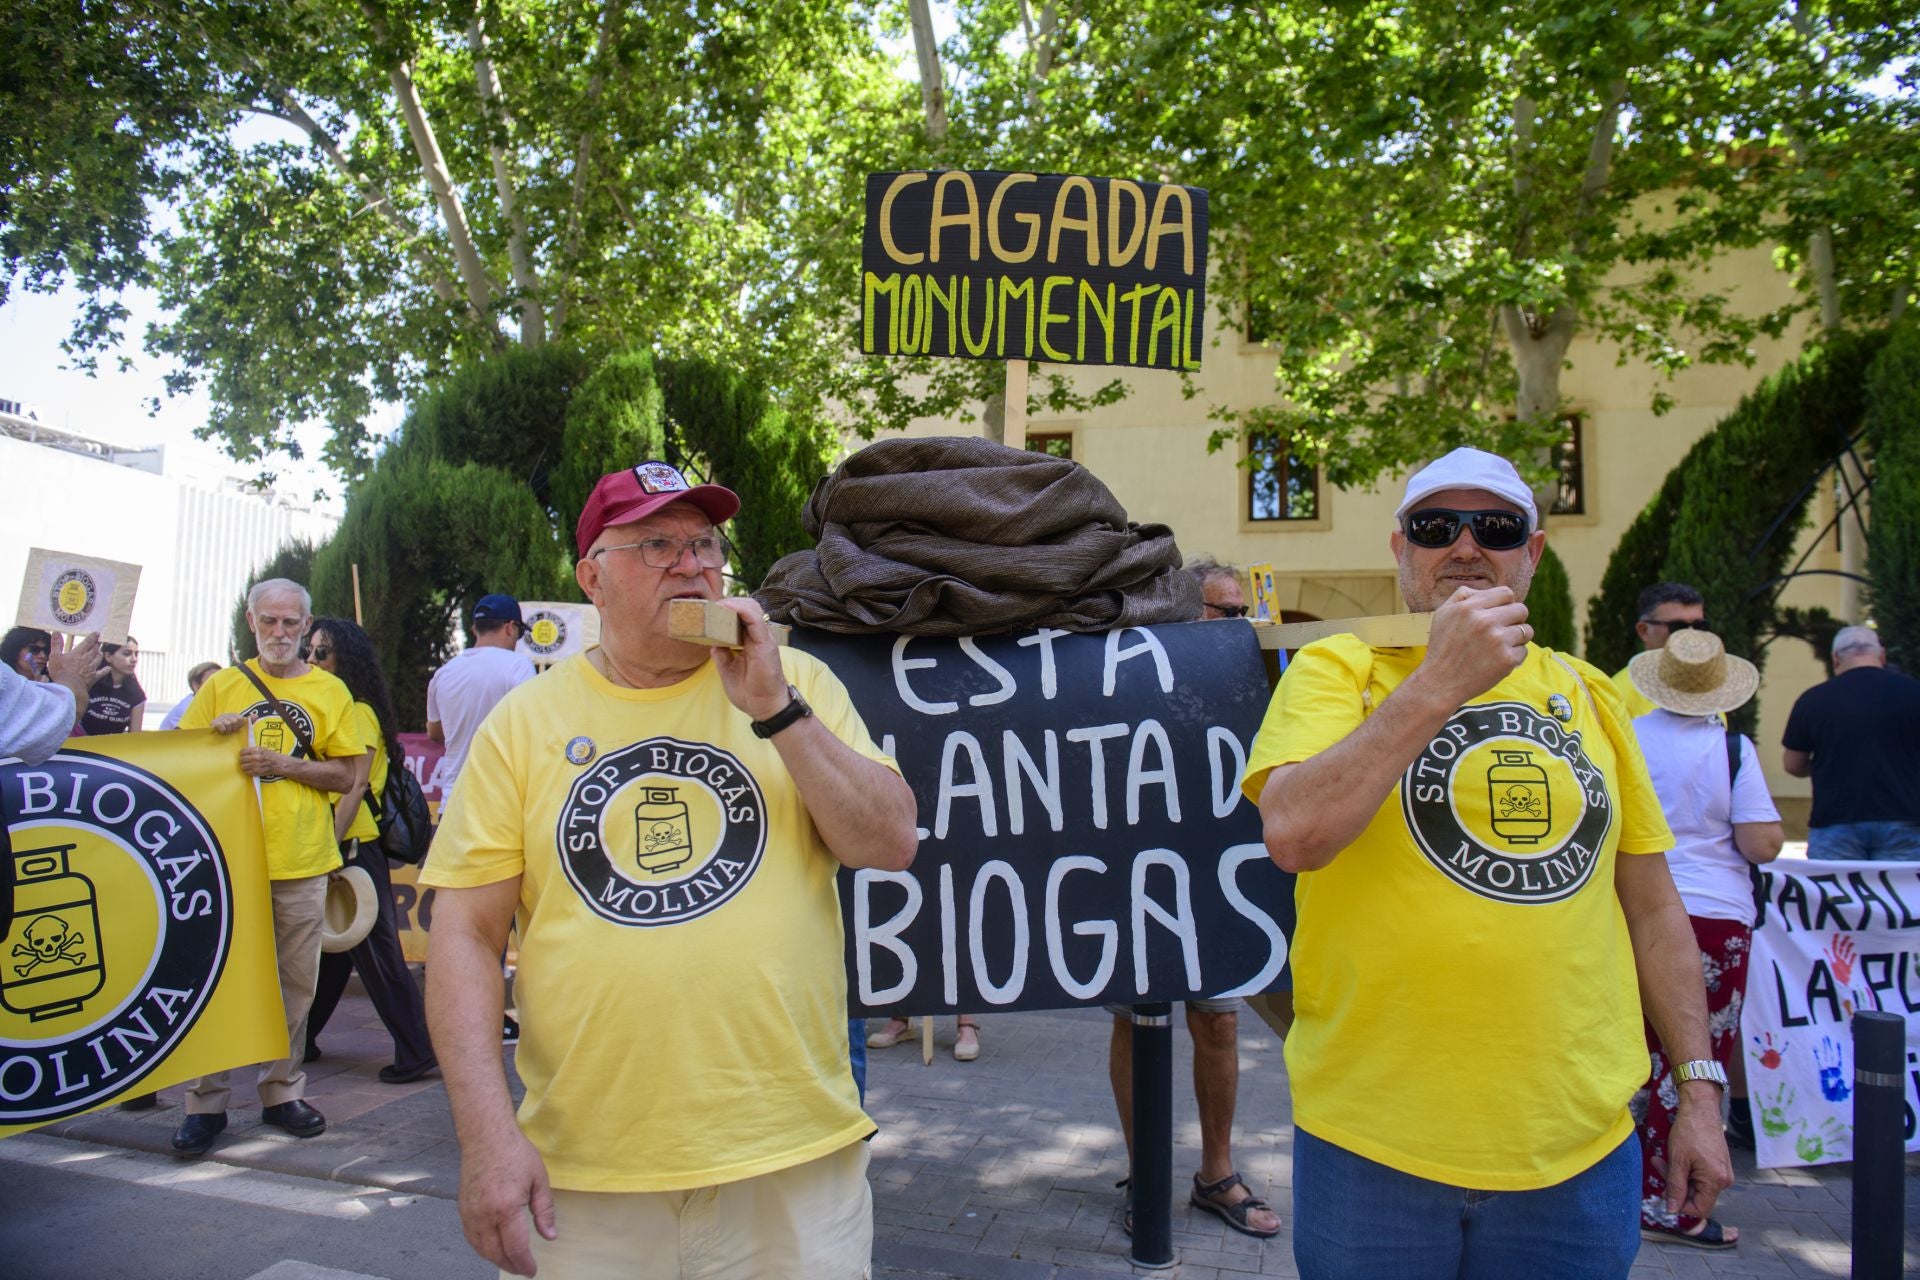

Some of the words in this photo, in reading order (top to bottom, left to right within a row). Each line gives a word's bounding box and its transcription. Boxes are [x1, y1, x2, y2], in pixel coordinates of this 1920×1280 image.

[879, 170, 1194, 276] CAGADA
[863, 271, 1202, 371] MONUMENTAL
[892, 626, 1174, 715] ESTA
[568, 765, 620, 852] STOP
[649, 747, 755, 824] BIOGÁS
[1206, 725, 1256, 819] D
[1415, 723, 1469, 804] STOP
[16, 771, 213, 922] BIOGÁS
[598, 856, 745, 915] MOLINA
[1447, 840, 1592, 891] MOLINA
[853, 843, 1288, 1006] BIOGAS
[1757, 870, 1920, 933] PARAL
[1771, 958, 1843, 1027] LA
[0, 985, 195, 1102] OLINA
